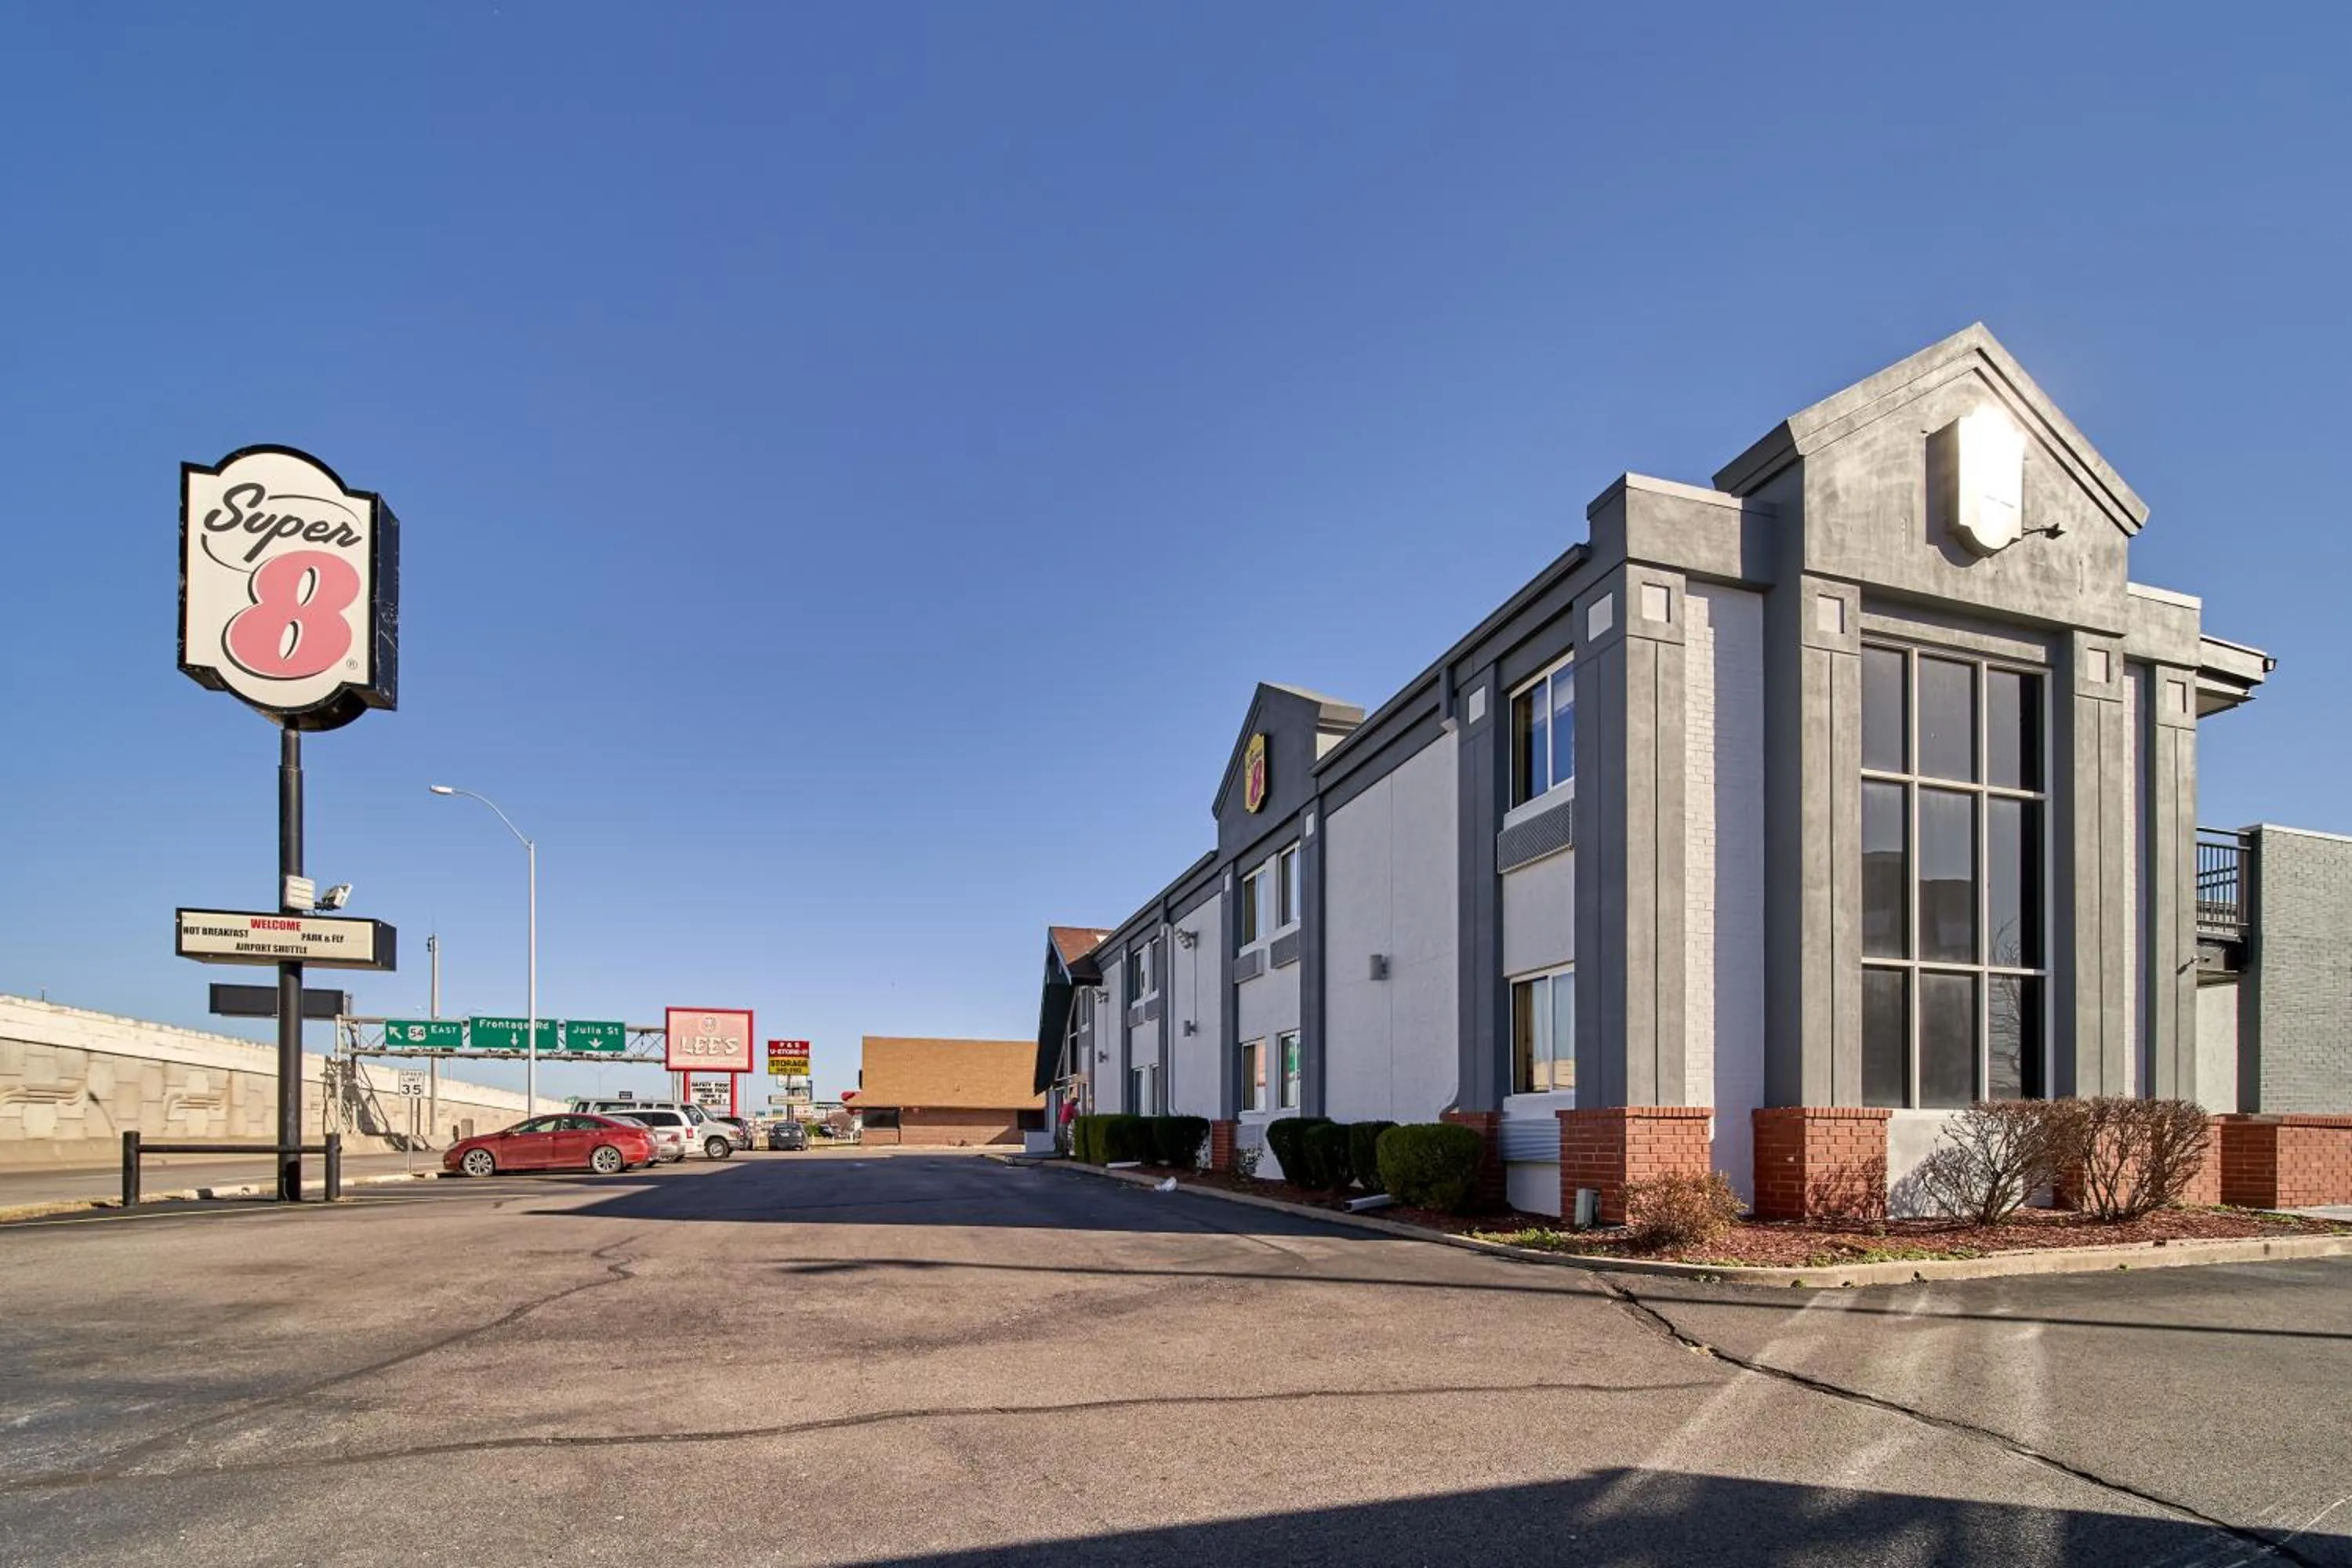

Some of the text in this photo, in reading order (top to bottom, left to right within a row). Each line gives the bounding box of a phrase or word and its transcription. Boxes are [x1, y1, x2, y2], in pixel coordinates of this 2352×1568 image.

[203, 482, 362, 564] Super
[220, 550, 361, 681] 8
[250, 918, 302, 931] WELCOME
[183, 926, 249, 938] HOT BREAKFAST
[301, 933, 322, 942] PARK
[332, 934, 344, 943] FLY
[235, 942, 307, 954] AIRPORT SHUTTLE
[410, 1025, 458, 1038] 54 EAST
[479, 1019, 550, 1032] Frontage Rd
[572, 1025, 619, 1036] Julia St
[679, 1035, 739, 1055] LEE'S
[401, 1084, 421, 1095] 35
